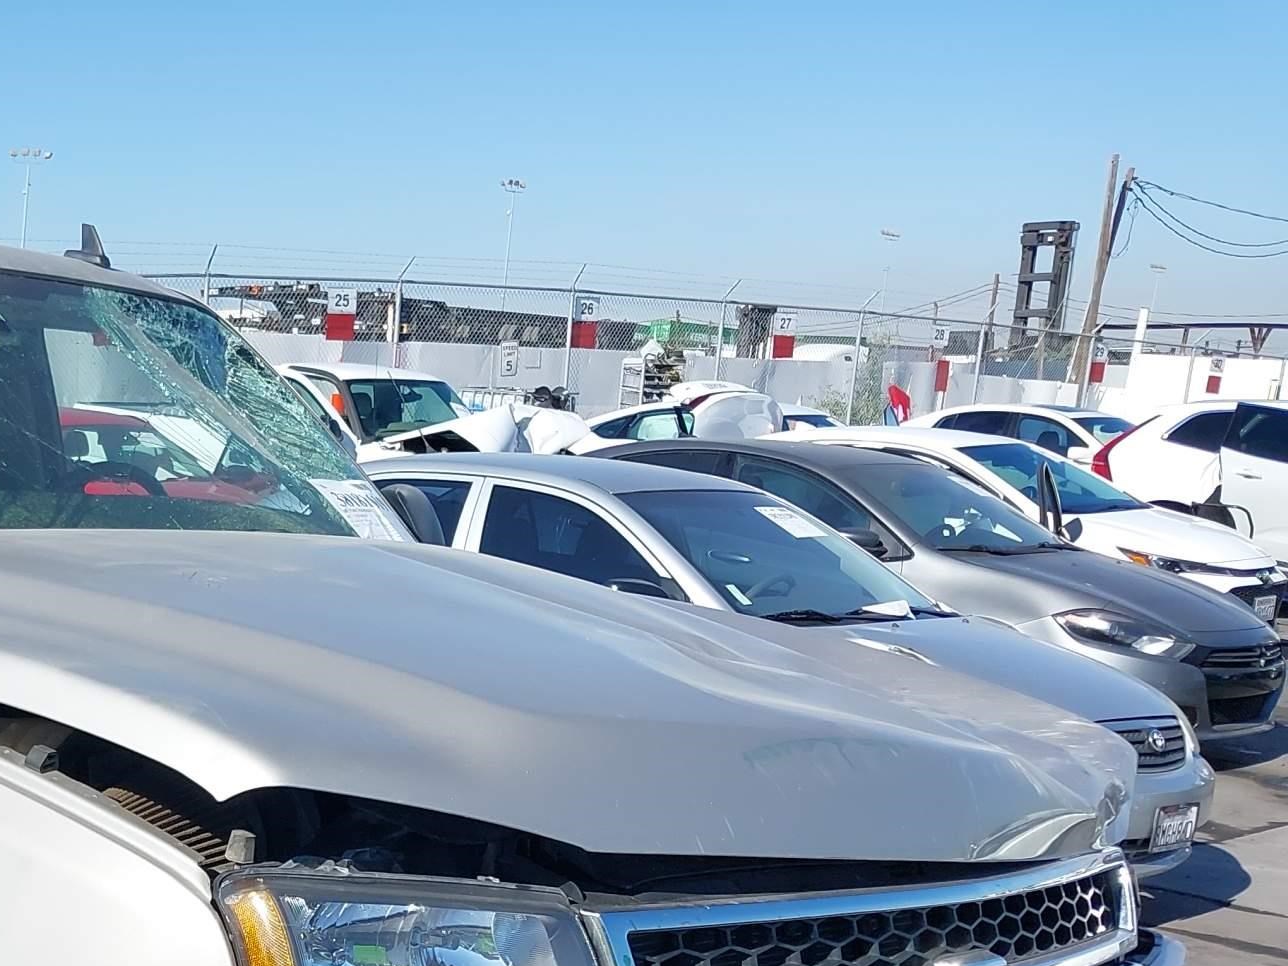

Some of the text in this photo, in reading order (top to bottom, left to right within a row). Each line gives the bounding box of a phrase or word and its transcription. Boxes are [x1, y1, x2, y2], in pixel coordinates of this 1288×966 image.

[335, 293, 350, 308] 25
[580, 302, 594, 316] 26
[780, 317, 793, 330] 27
[934, 328, 945, 341] 28
[1095, 346, 1105, 358] 29
[505, 360, 513, 373] 5
